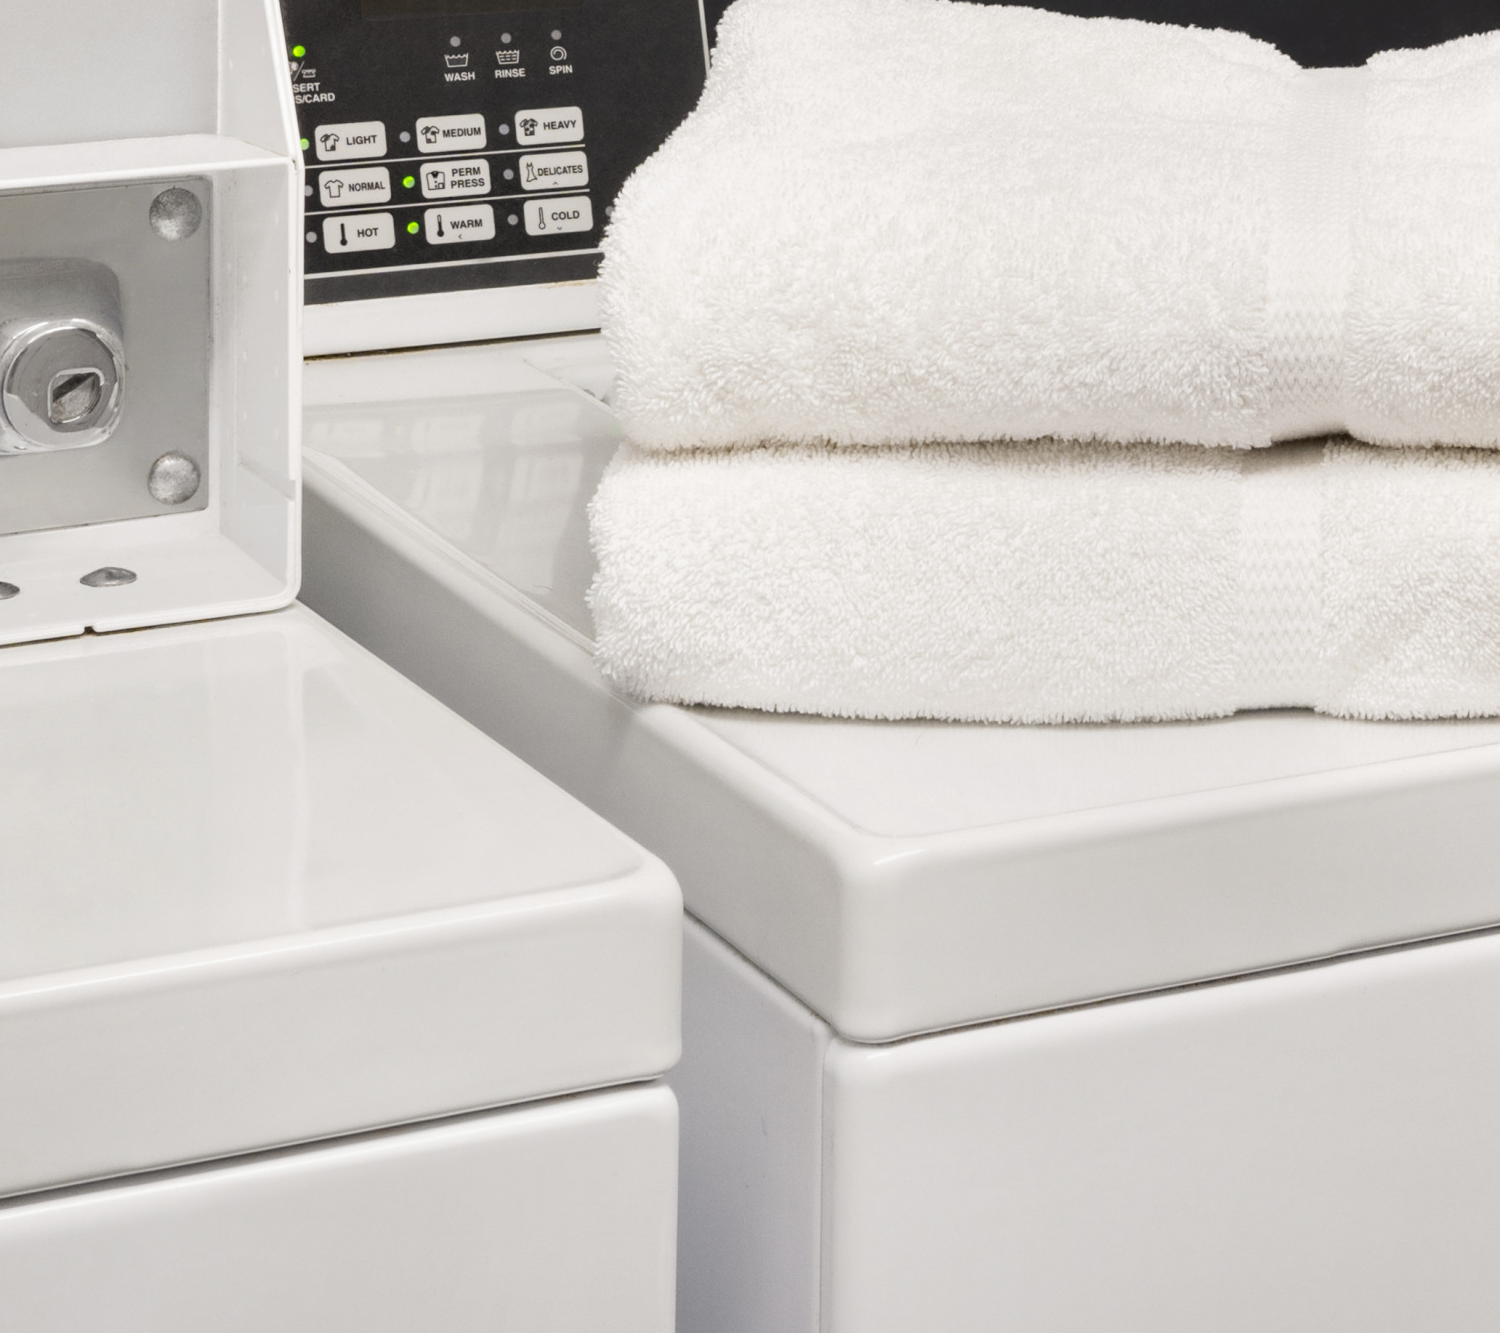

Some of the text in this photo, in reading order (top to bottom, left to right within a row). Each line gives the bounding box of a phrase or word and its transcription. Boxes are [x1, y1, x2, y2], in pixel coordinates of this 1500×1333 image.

[494, 68, 526, 79] RINSE
[548, 65, 573, 75] SPIN
[444, 71, 476, 82] WASH
[292, 82, 320, 93] SERT
[295, 92, 336, 104] S/CARD
[543, 119, 577, 131] HEAVY
[442, 127, 481, 139] MEDIUM
[346, 135, 377, 146] LIGHT
[451, 166, 481, 177] PERM
[537, 164, 583, 177] DELICATES
[348, 180, 386, 192] NORMAL
[450, 177, 485, 189] PRESS
[551, 210, 580, 221] COLD
[450, 218, 483, 230] WARM
[357, 227, 379, 238] HOT
